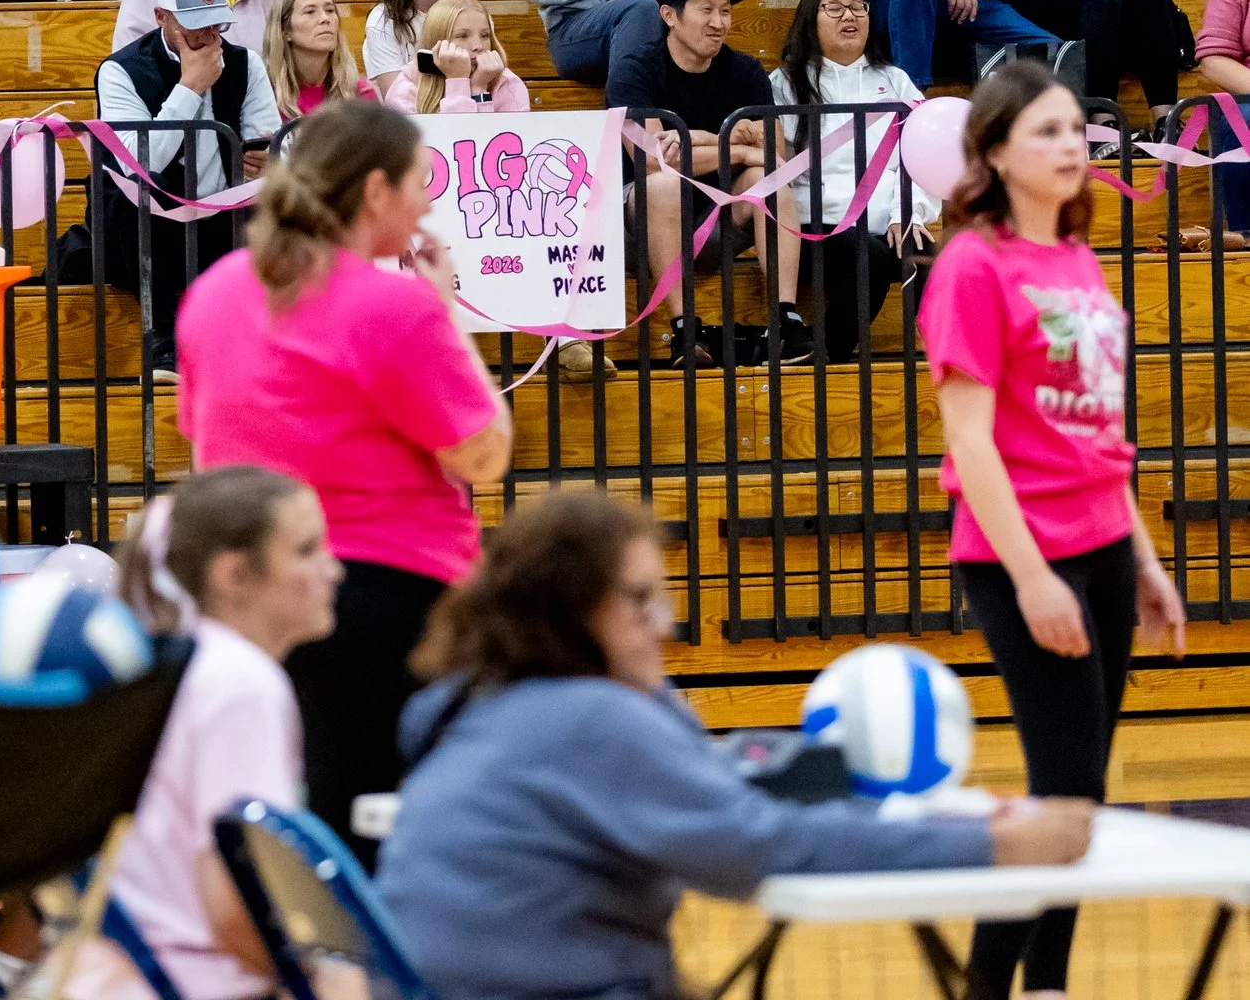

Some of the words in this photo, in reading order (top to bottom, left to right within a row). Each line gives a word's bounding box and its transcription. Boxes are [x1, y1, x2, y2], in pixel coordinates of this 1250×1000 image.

[458, 186, 578, 238] PINK
[480, 255, 523, 275] 2026
[553, 276, 606, 297] PIRCE
